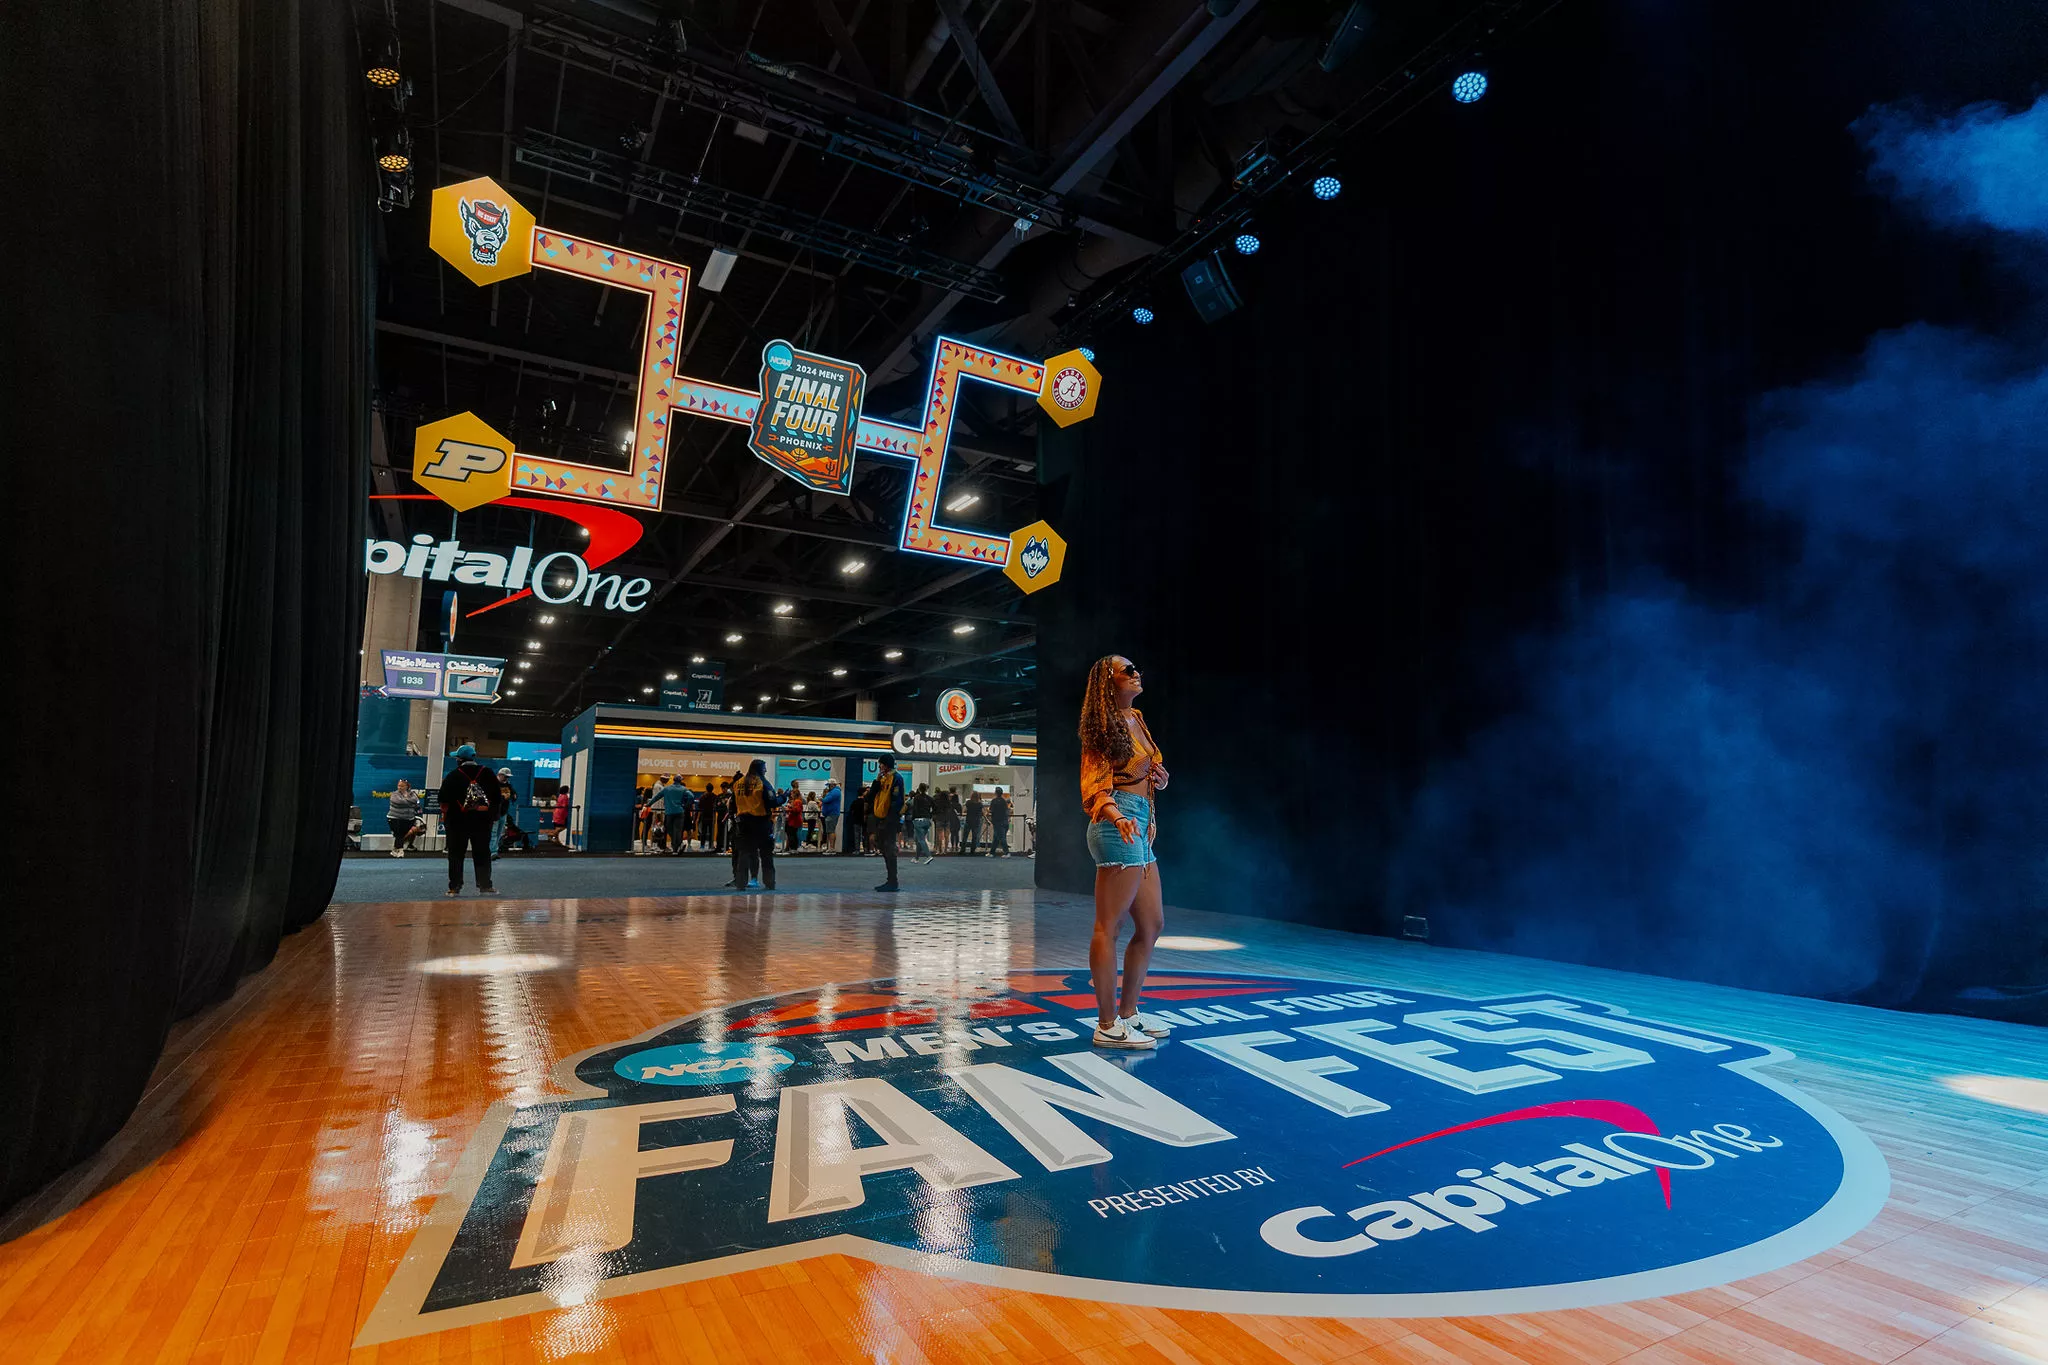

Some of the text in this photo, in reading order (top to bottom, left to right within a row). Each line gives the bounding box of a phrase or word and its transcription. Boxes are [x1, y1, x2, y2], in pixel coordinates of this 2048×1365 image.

[770, 356, 792, 367] NCAA
[796, 364, 845, 382] 2024 MEN'S
[1056, 369, 1086, 390] ALABAMA
[774, 373, 841, 412] FINAL
[770, 400, 838, 438] FOUR
[779, 435, 823, 451] PHOENIX
[421, 438, 507, 483] P
[415, 657, 441, 669] Mart
[446, 660, 500, 677] Chuck Stop
[401, 675, 424, 685] 1938
[695, 702, 721, 711] LACROSSE
[925, 730, 943, 739] THE
[893, 729, 1012, 766] Chuck Stop
[677, 759, 689, 768] OF
[692, 760, 707, 769] THE
[710, 760, 741, 770] MONTH
[938, 764, 962, 773] SLUSH
[823, 1021, 1079, 1064] MEN'S
[1250, 991, 1416, 1015] FOUR
[641, 1054, 795, 1080] NCAA
[510, 1000, 1732, 1269] FAN FEST
[1088, 1166, 1275, 1219] PRESENTED BY
